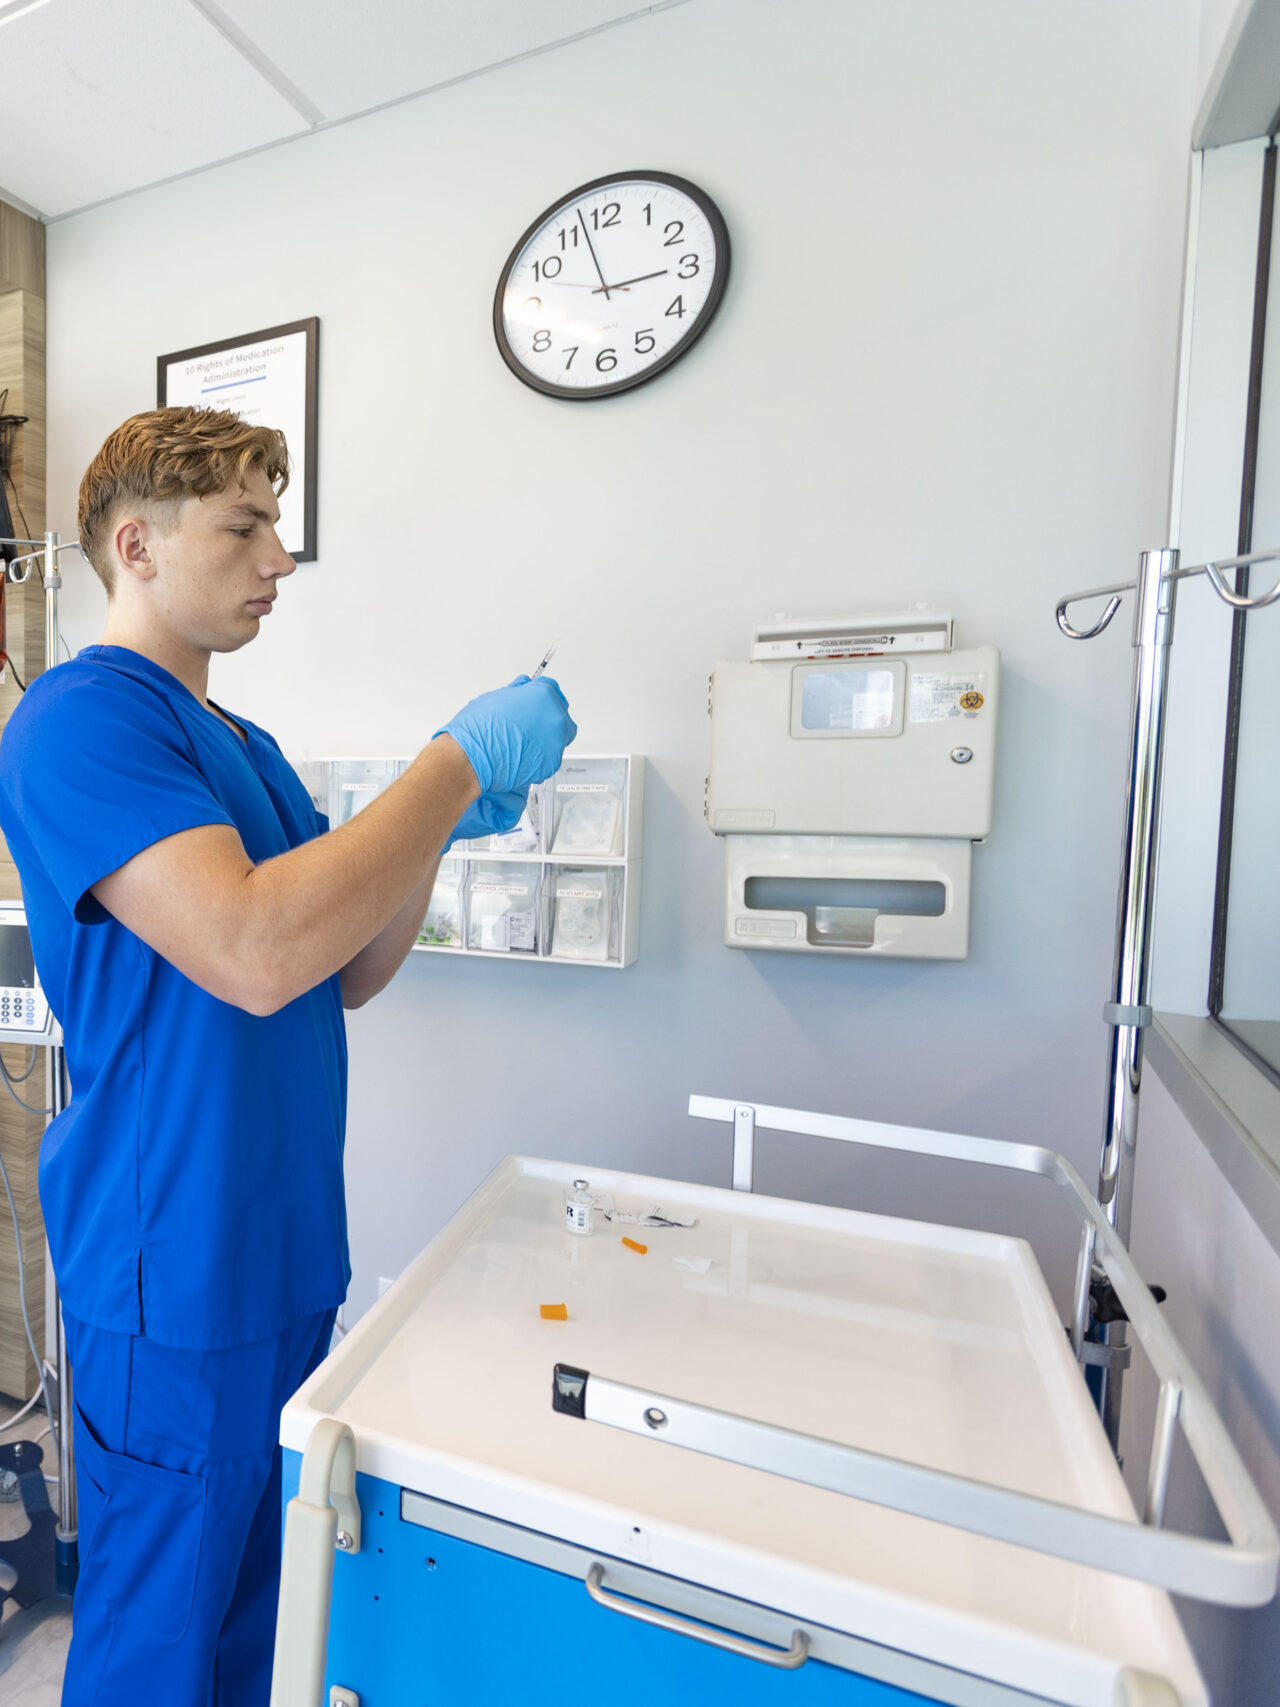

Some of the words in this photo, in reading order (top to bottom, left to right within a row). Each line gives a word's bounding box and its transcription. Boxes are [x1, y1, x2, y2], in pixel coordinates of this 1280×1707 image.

[590, 202, 622, 231] 12
[642, 202, 652, 227] 1
[557, 224, 579, 251] 11
[663, 220, 685, 247] 2
[531, 255, 562, 283] 10
[677, 253, 700, 280] 3
[664, 294, 687, 319] 4
[532, 329, 552, 353] 8
[634, 328, 656, 355] 5
[185, 365, 195, 376] 10
[197, 359, 223, 373] Rights
[225, 356, 234, 366] of
[235, 345, 284, 362] Medication
[562, 346, 579, 370] 7
[595, 348, 618, 372] 6
[202, 363, 267, 384] Administration
